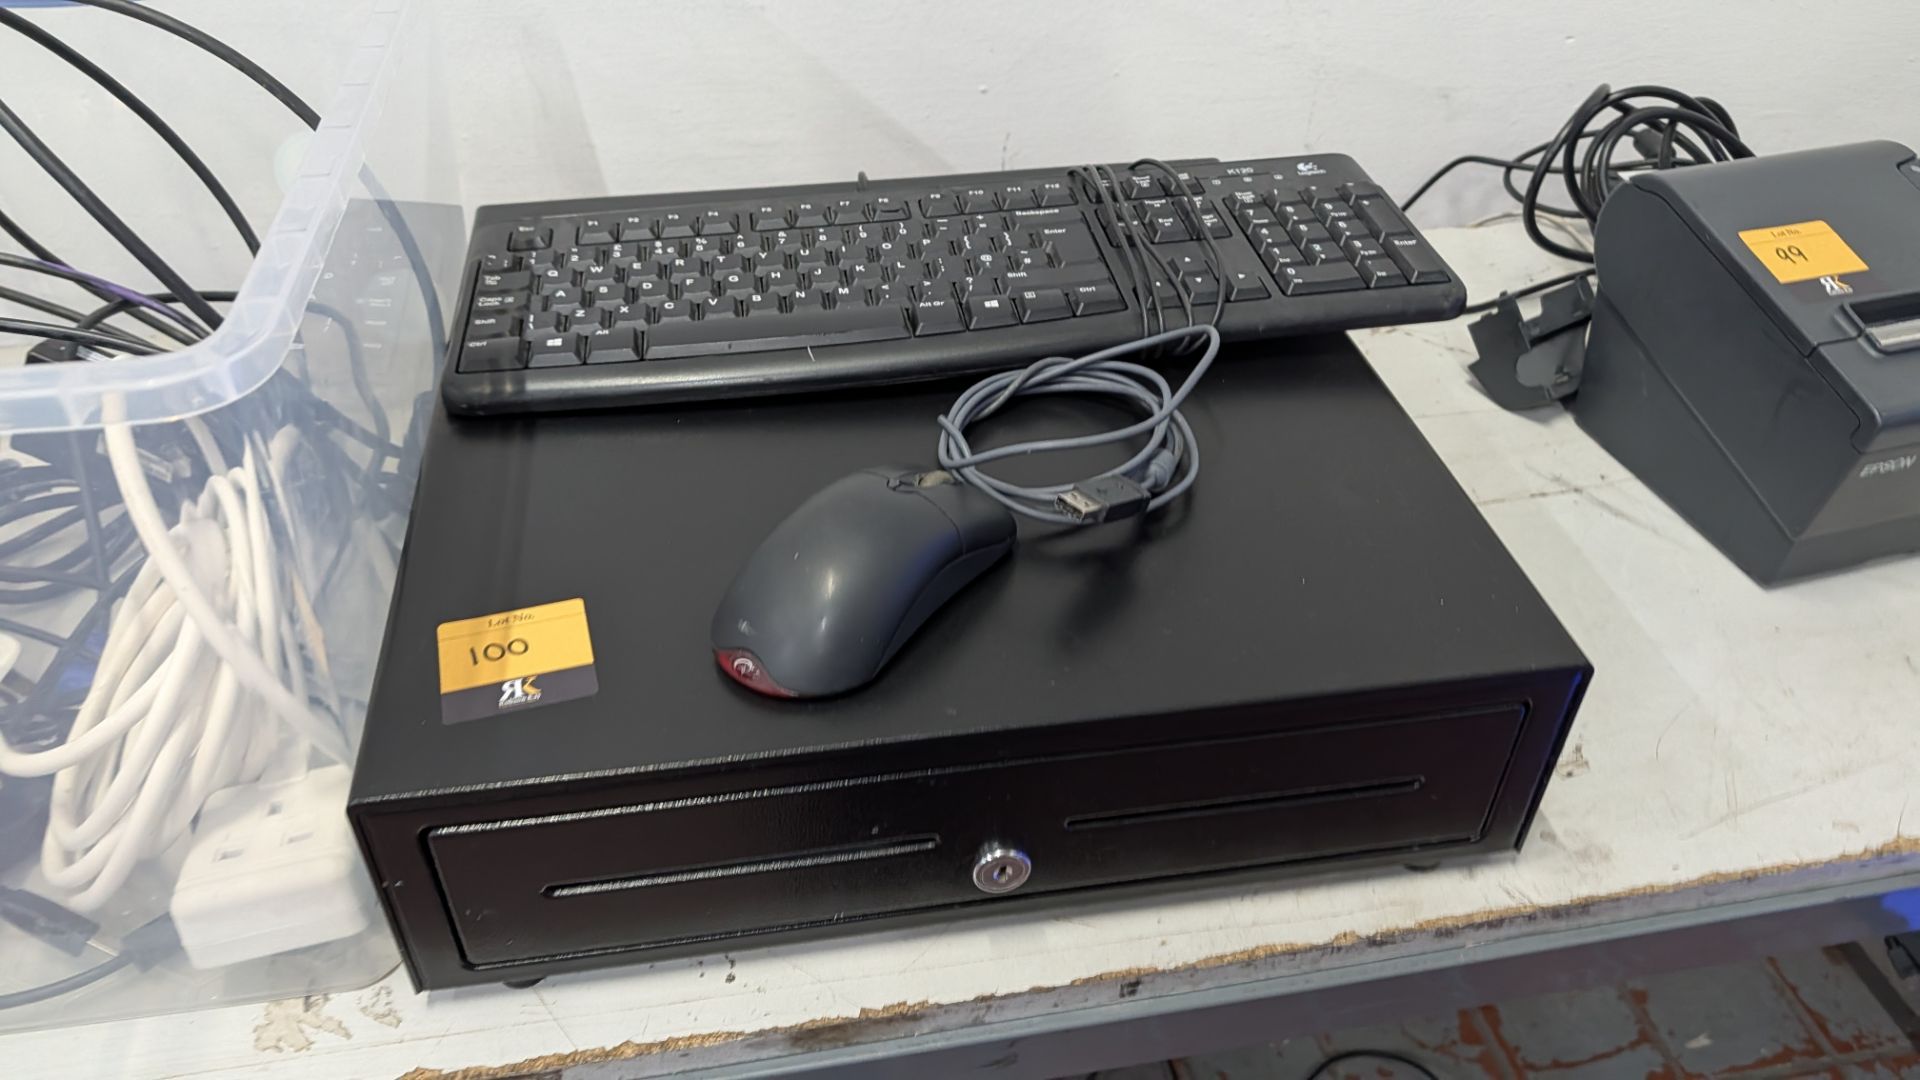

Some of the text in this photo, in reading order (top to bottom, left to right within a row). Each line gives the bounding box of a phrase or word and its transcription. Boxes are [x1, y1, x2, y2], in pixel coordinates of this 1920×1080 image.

[881, 242, 892, 250] O
[716, 255, 726, 263] T
[1775, 245, 1809, 265] 99
[632, 262, 642, 270] E
[675, 258, 685, 266] R
[897, 261, 906, 269] L
[547, 269, 559, 277] Q
[814, 268, 822, 276] J
[855, 265, 866, 273] K
[1286, 267, 1296, 275] 0
[771, 271, 781, 279] H
[642, 282, 653, 290] D
[685, 278, 695, 286] F
[795, 290, 806, 299] N
[838, 287, 850, 295] M
[708, 298, 718, 306] V
[752, 294, 762, 302] B
[619, 305, 629, 313] X
[664, 302, 675, 310] C
[575, 309, 586, 317] Z
[469, 637, 529, 667] 100
